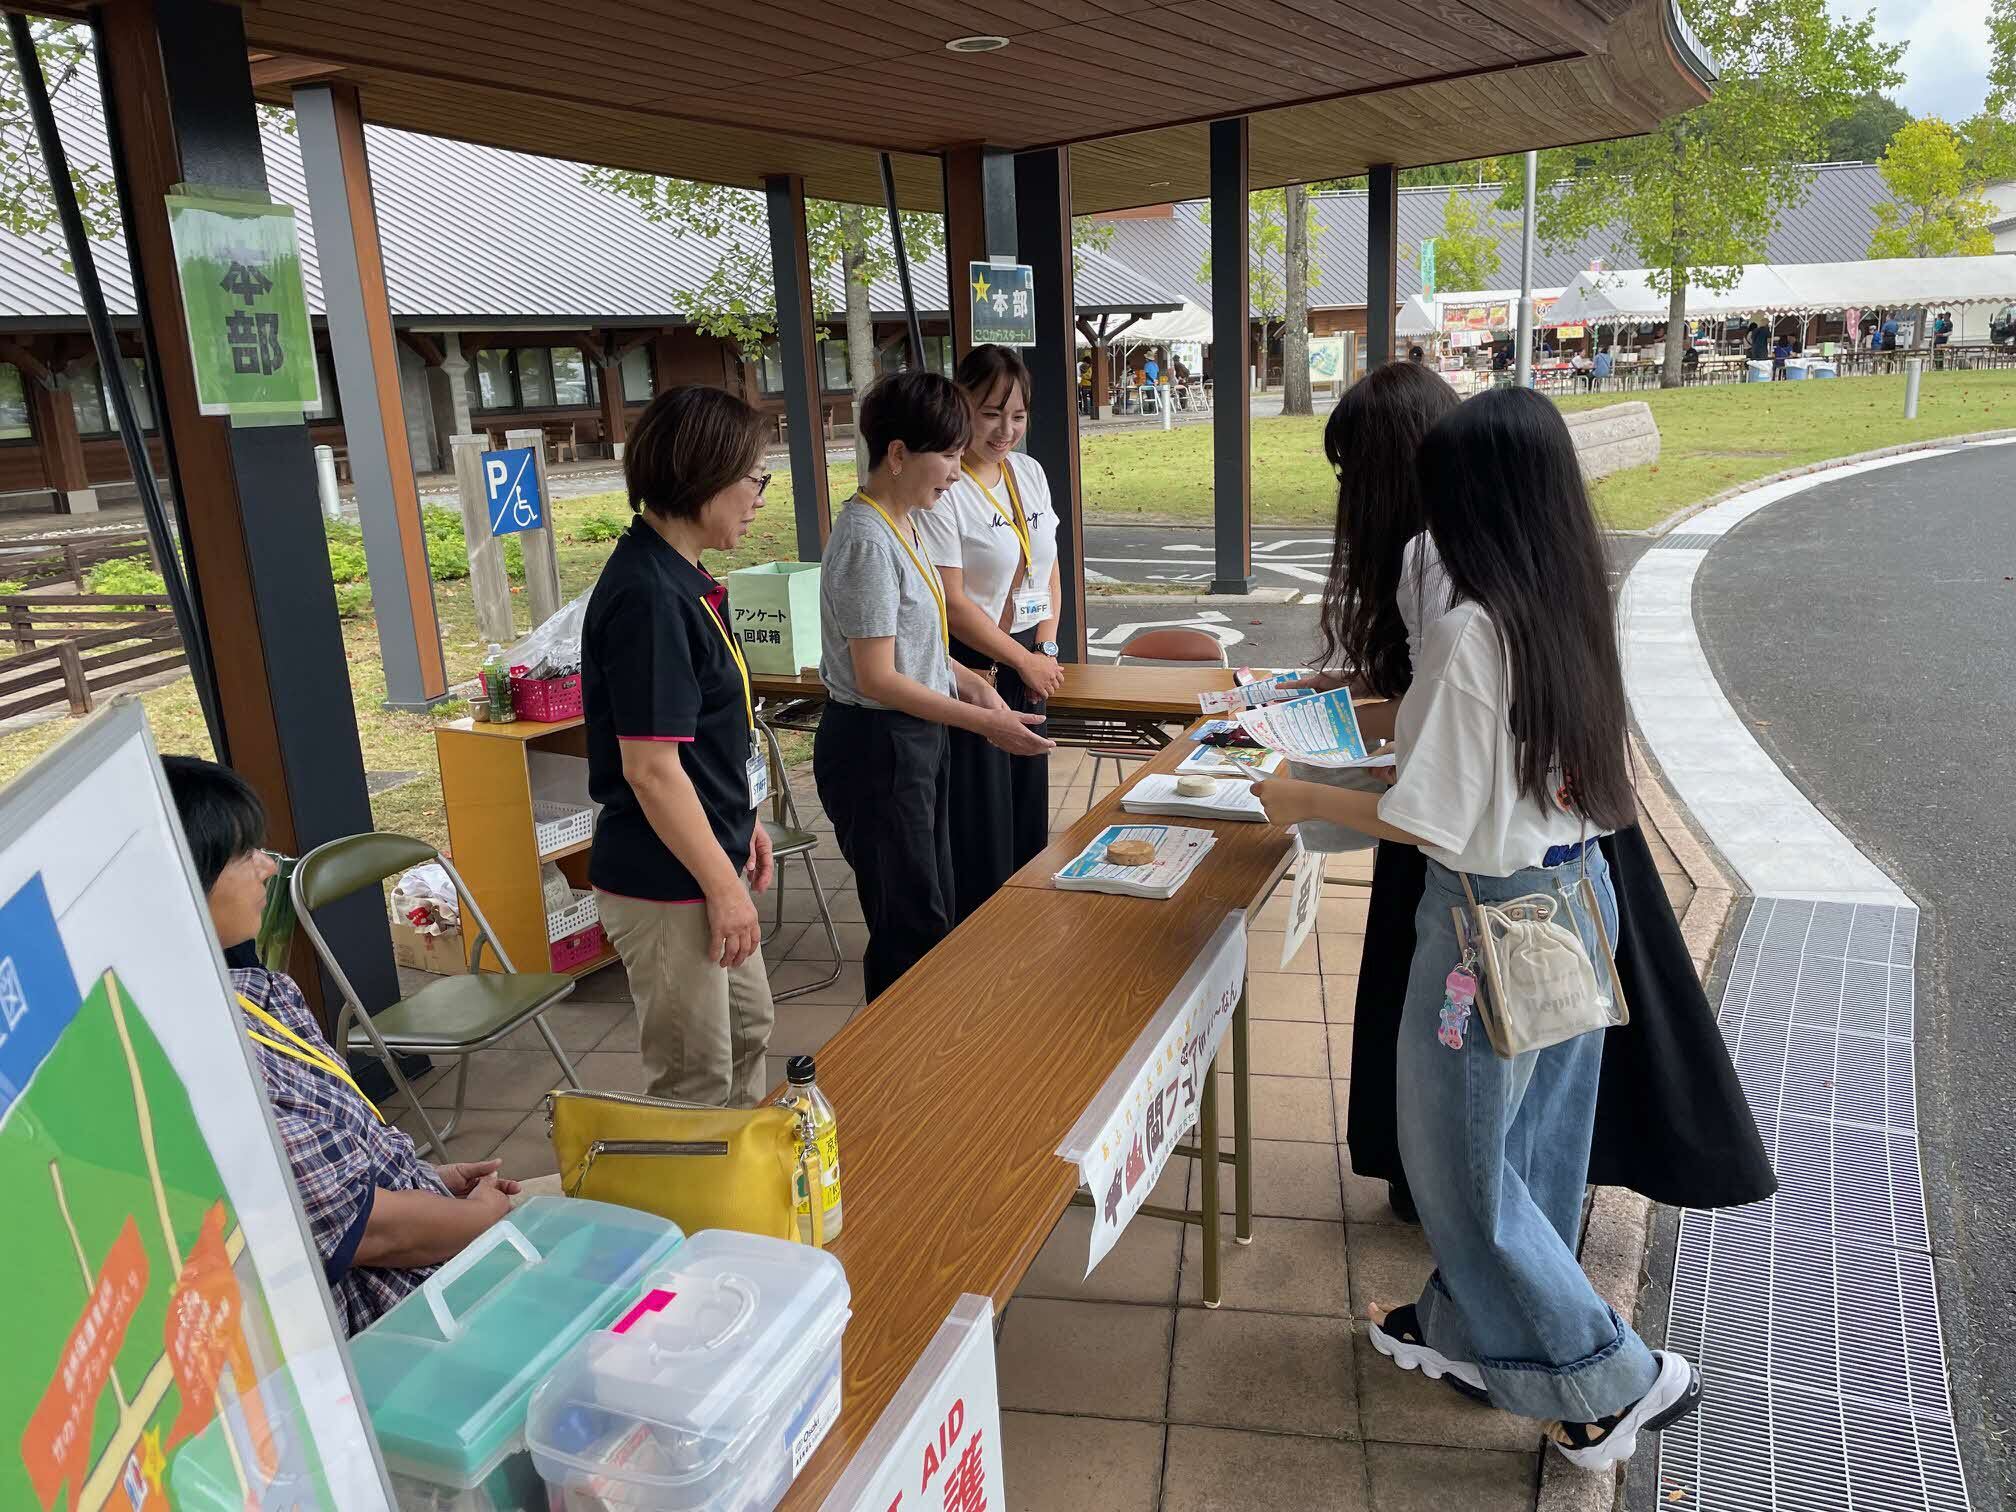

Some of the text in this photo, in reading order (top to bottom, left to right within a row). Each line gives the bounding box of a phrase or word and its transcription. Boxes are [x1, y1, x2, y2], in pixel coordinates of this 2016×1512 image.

[992, 289, 1028, 318] 本部
[486, 460, 508, 500] P
[735, 608, 787, 623] アンケート
[1020, 604, 1048, 615] STAFF
[744, 629, 781, 644] 回収箱
[753, 778, 767, 795] STAFF
[921, 1398, 965, 1496] AID
